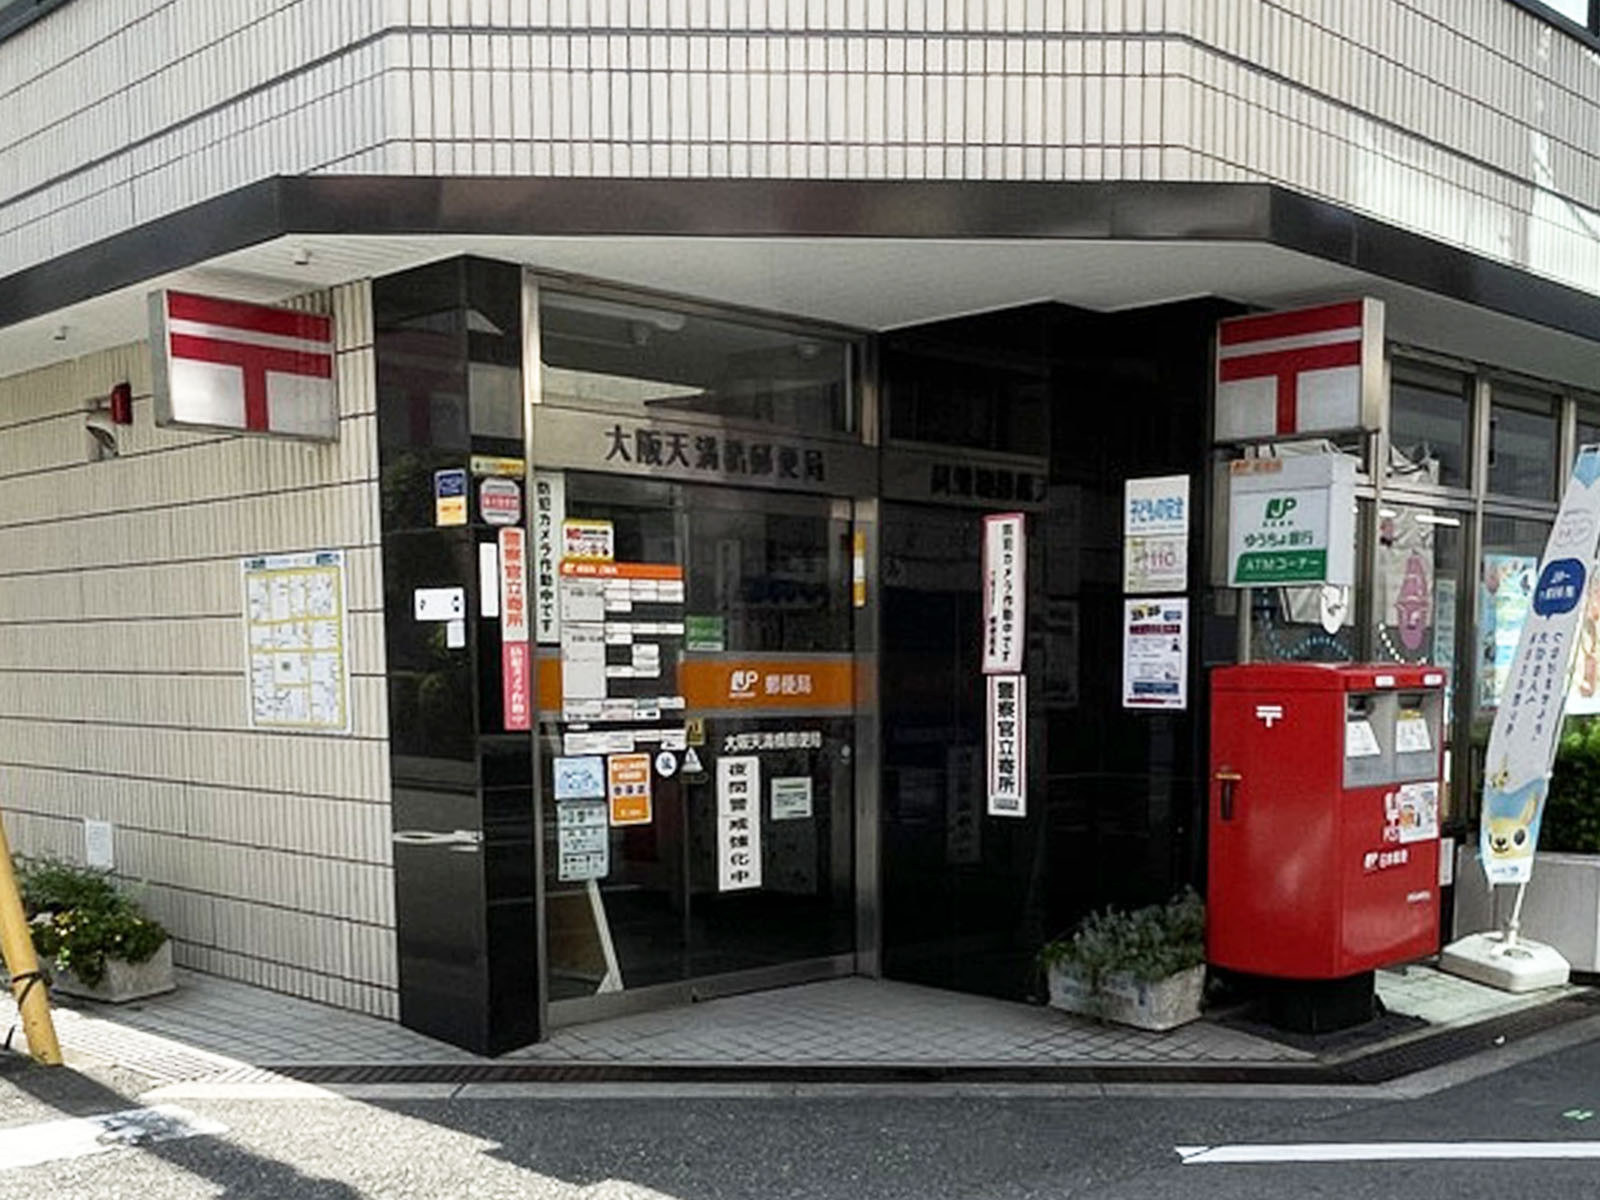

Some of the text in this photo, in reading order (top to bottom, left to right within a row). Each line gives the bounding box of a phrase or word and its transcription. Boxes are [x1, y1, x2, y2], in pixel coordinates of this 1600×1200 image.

[1244, 530, 1313, 547] ゆうちょ銀行
[1244, 557, 1320, 572] ATMコーナー
[764, 674, 813, 695] 郵便局
[997, 681, 1015, 794] 警察官立寄所
